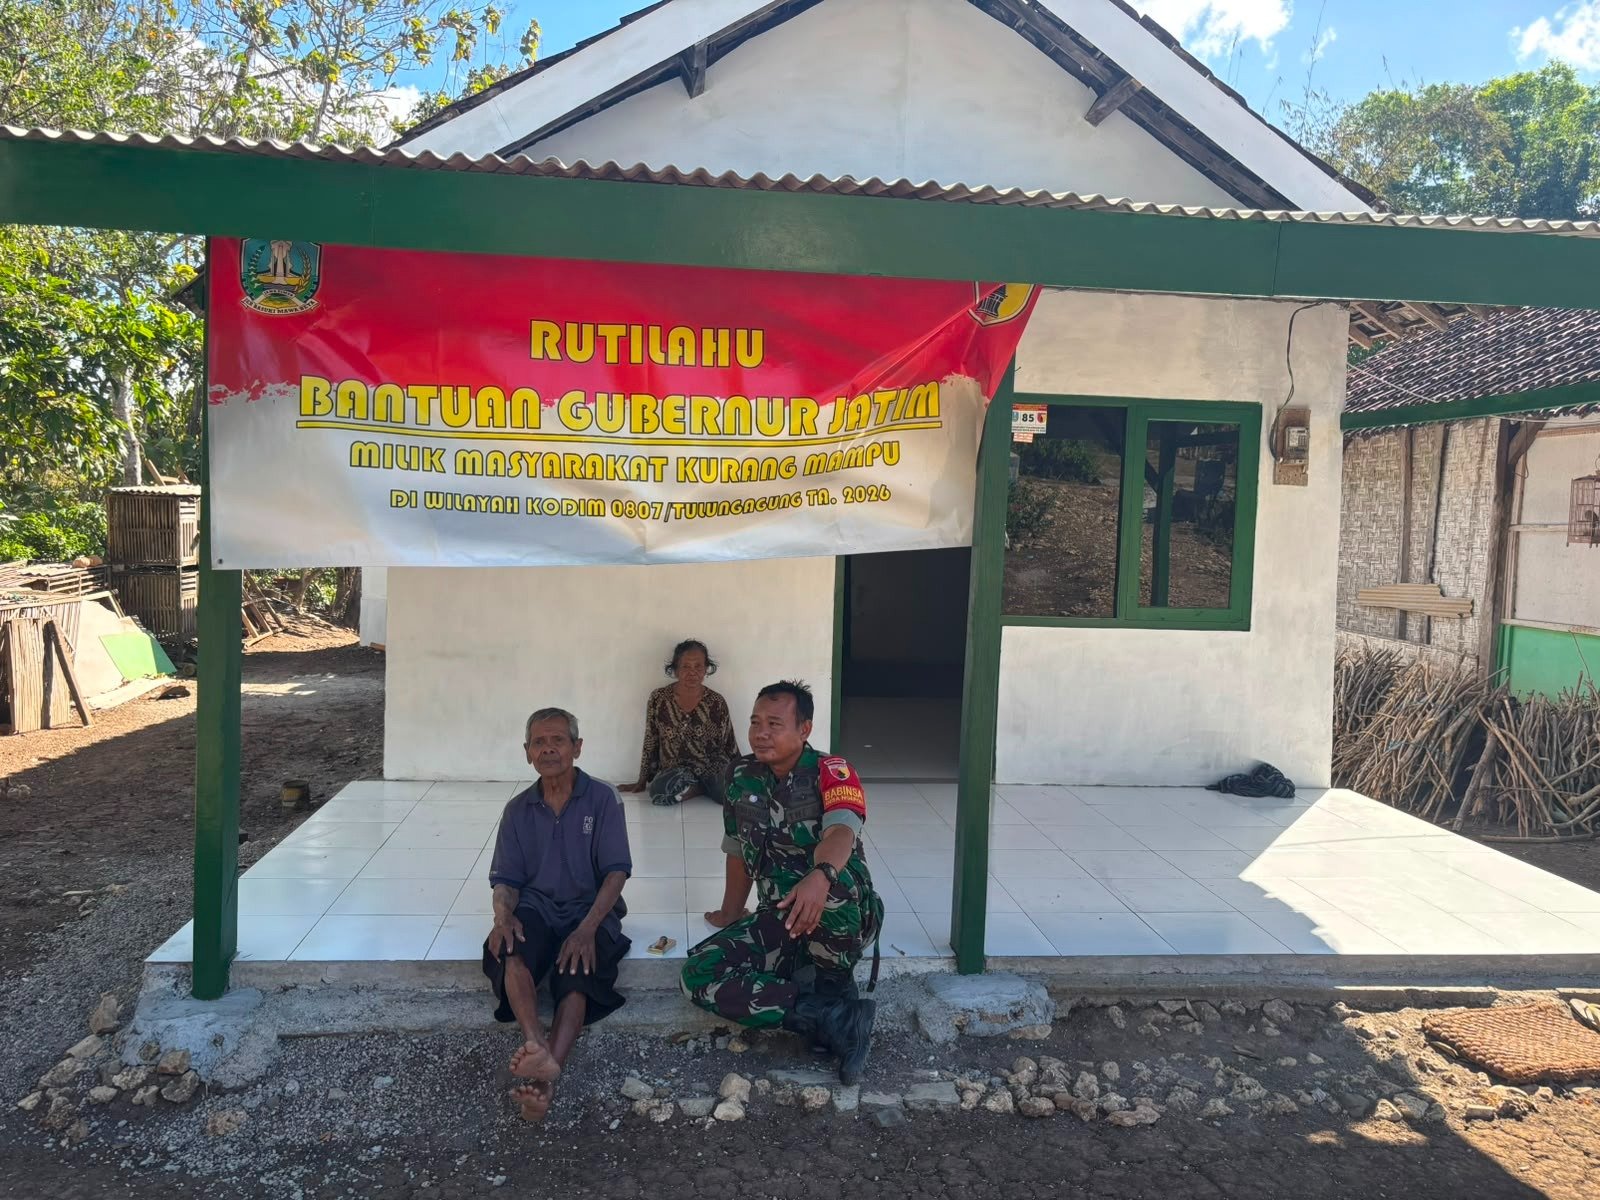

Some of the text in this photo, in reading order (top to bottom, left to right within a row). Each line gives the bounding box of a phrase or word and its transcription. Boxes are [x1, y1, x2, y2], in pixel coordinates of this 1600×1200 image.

[529, 319, 765, 368] RUTILAHU
[299, 375, 941, 437] BANTUAN GUBERNUR JATIM
[1022, 413, 1035, 423] 85
[350, 440, 901, 484] MILIK MASYARAKAT KURANG MAMPU
[390, 484, 891, 523] DI WILAYAH KODIM 0807/TULUNGAGUNG TA. 2026
[824, 786, 863, 800] BABINSA
